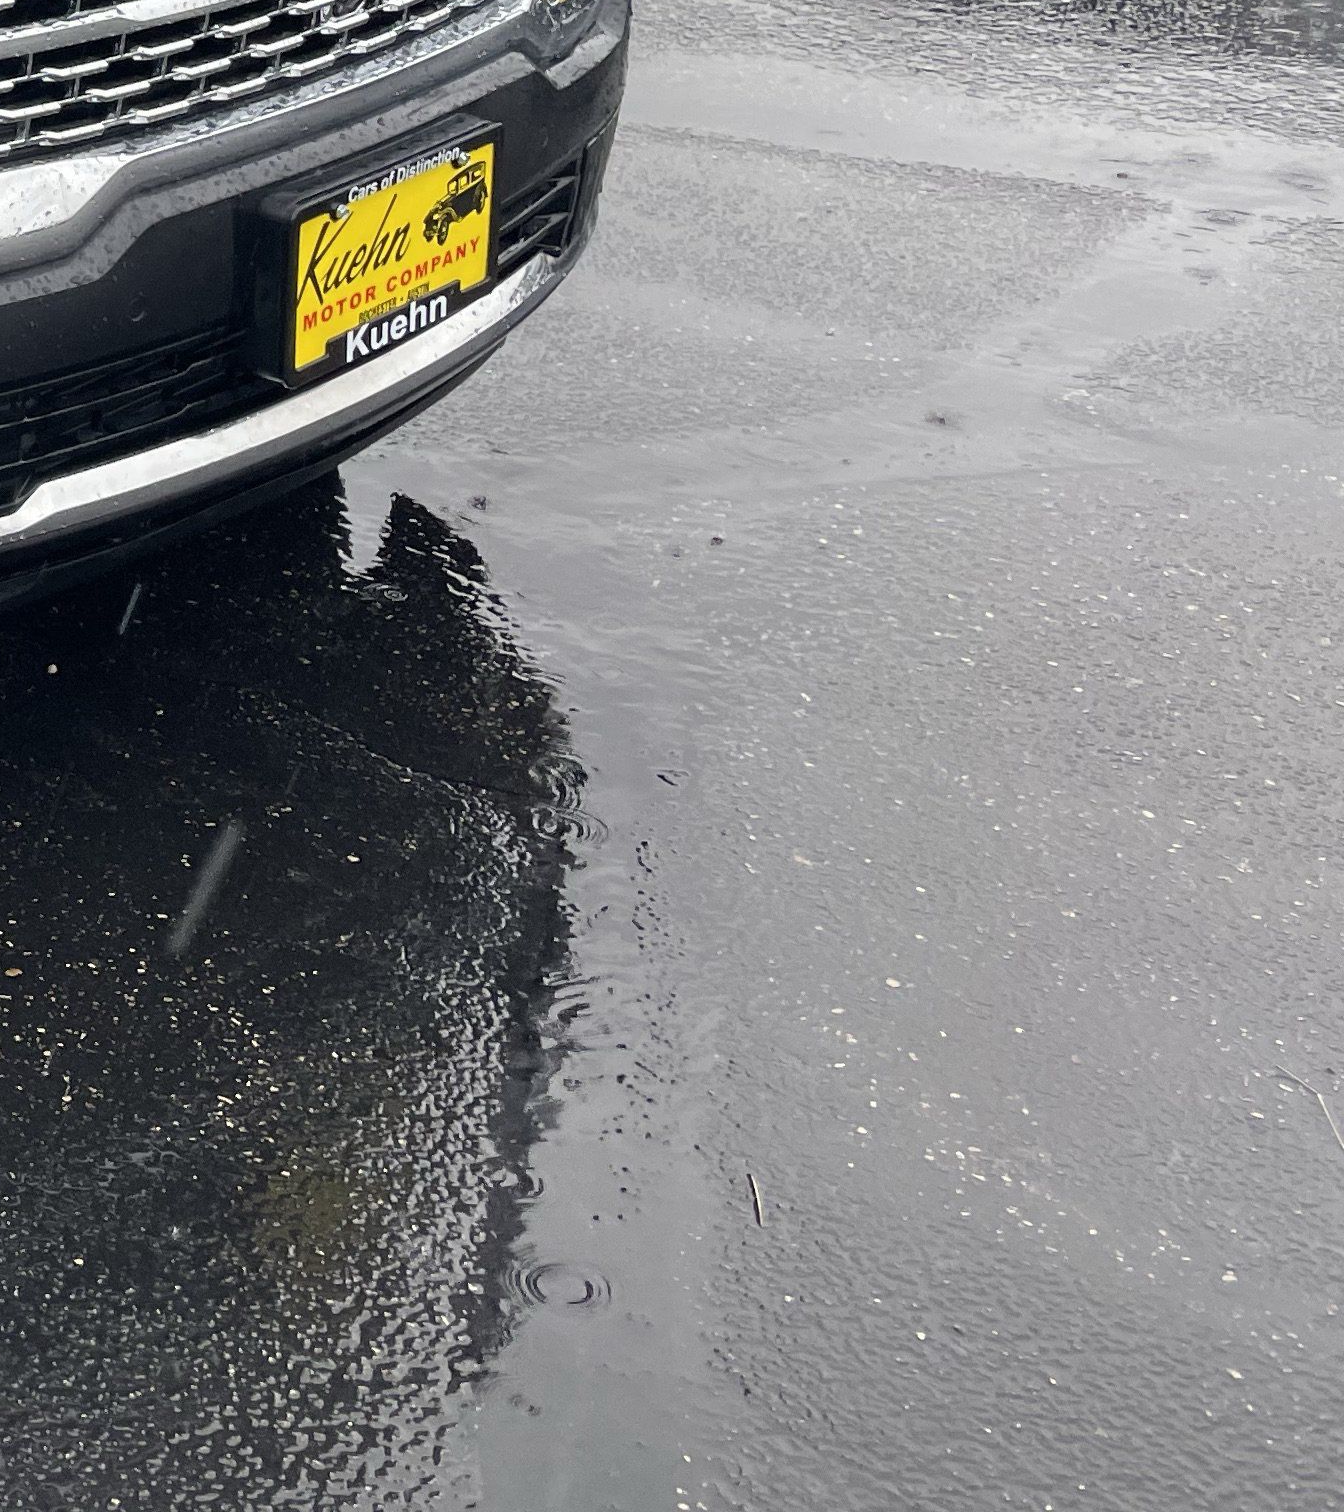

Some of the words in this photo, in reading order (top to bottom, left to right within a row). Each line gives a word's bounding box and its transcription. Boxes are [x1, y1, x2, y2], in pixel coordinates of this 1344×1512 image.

[348, 180, 378, 203] Cars
[380, 169, 396, 188] of
[396, 147, 460, 184] Distinction
[297, 193, 411, 305] Kuehn
[303, 285, 377, 332] MOTOR
[386, 236, 481, 292] COMPANY
[345, 294, 447, 363] Kuehn
